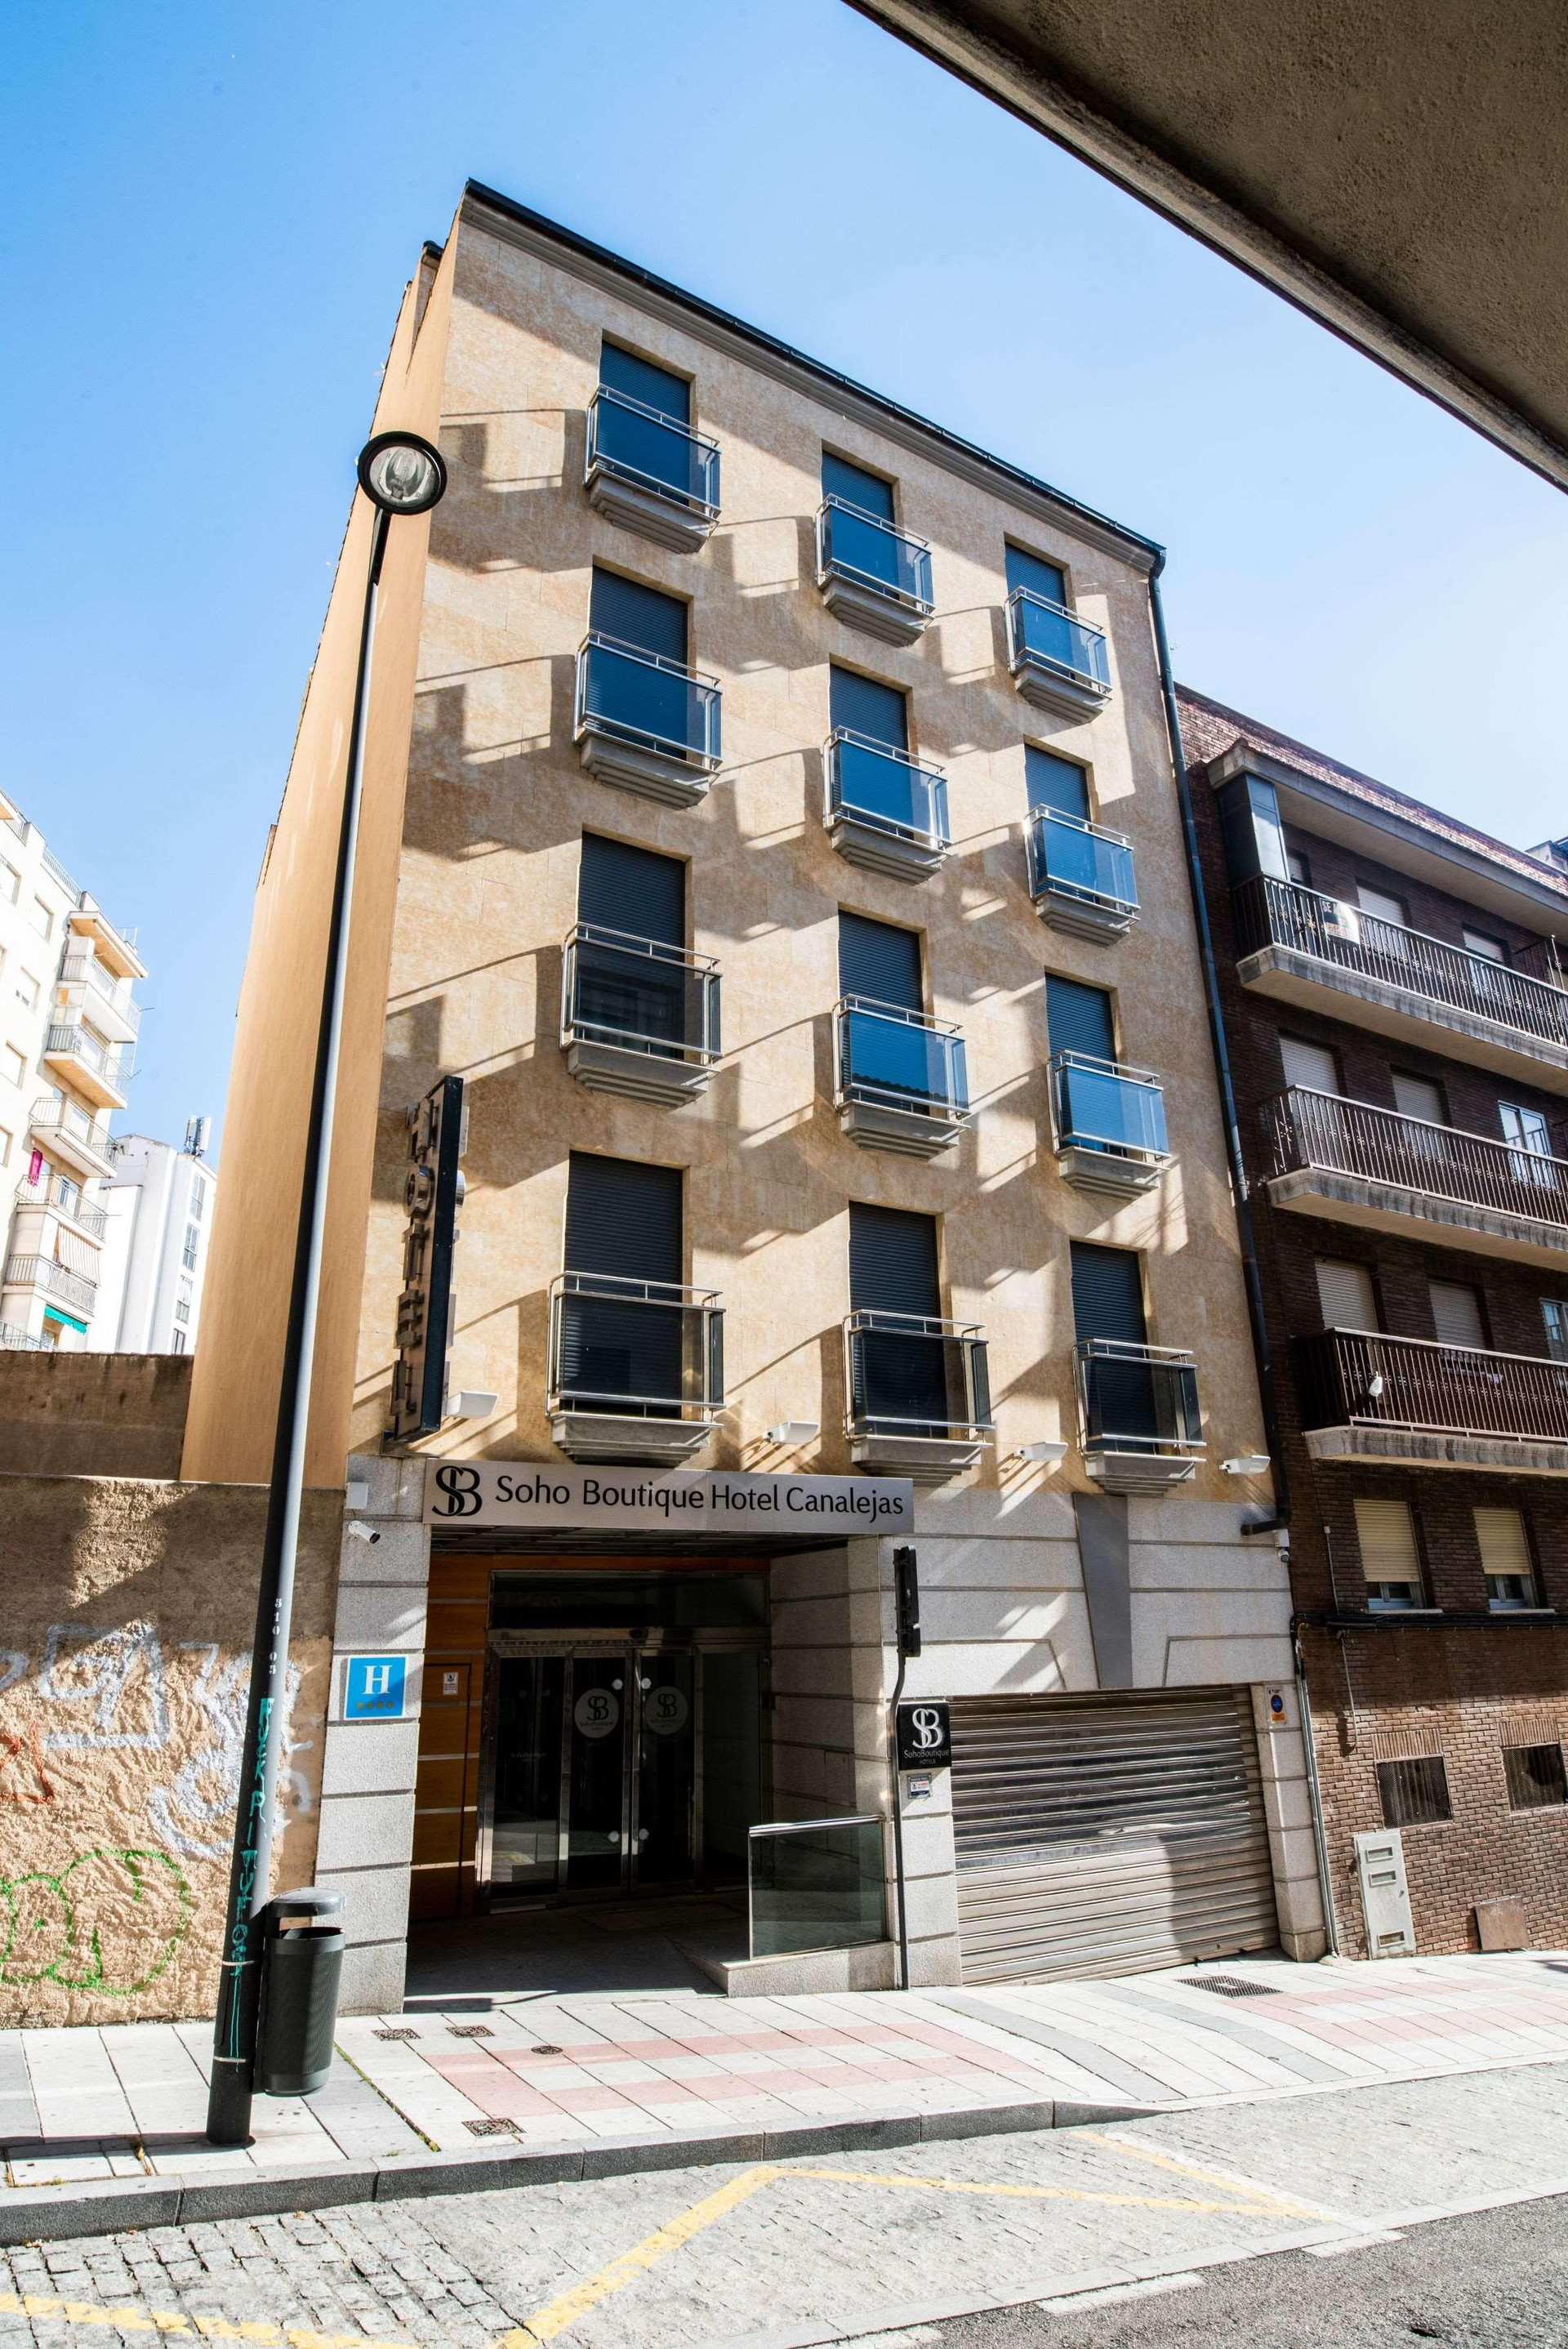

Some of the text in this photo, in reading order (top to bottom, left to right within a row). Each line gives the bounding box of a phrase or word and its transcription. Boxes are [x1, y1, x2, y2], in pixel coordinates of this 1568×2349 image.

[495, 1474, 904, 1523] Soho Boutique Hotel Canalejas
[361, 1665, 394, 1695] H
[903, 1749, 951, 1759] SohoBoutique
